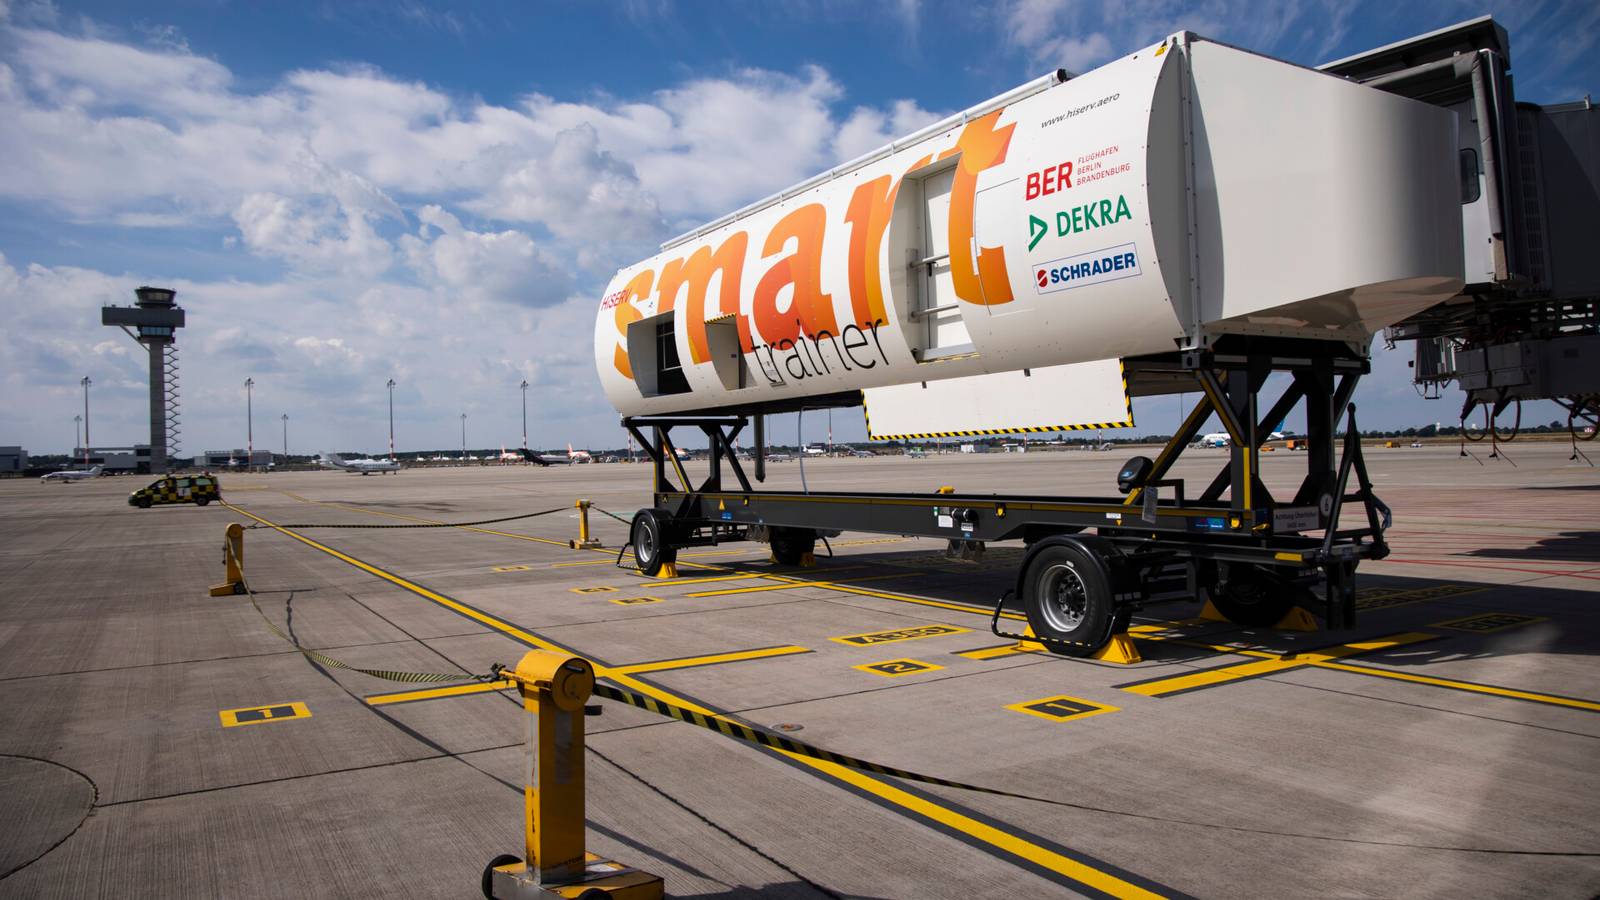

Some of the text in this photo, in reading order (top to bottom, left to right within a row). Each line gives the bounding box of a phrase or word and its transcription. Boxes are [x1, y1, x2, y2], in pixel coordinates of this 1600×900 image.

[1040, 93, 1120, 129] www.hiserv.aero
[1077, 145, 1120, 165] FLUGHAFEN
[1077, 161, 1102, 176] BERLIN
[1025, 161, 1073, 201] BER
[1076, 162, 1131, 186] BRANDENBURG
[1056, 194, 1132, 237] DEKRA
[1050, 252, 1136, 284] SCHRADER
[750, 318, 889, 384] trainer
